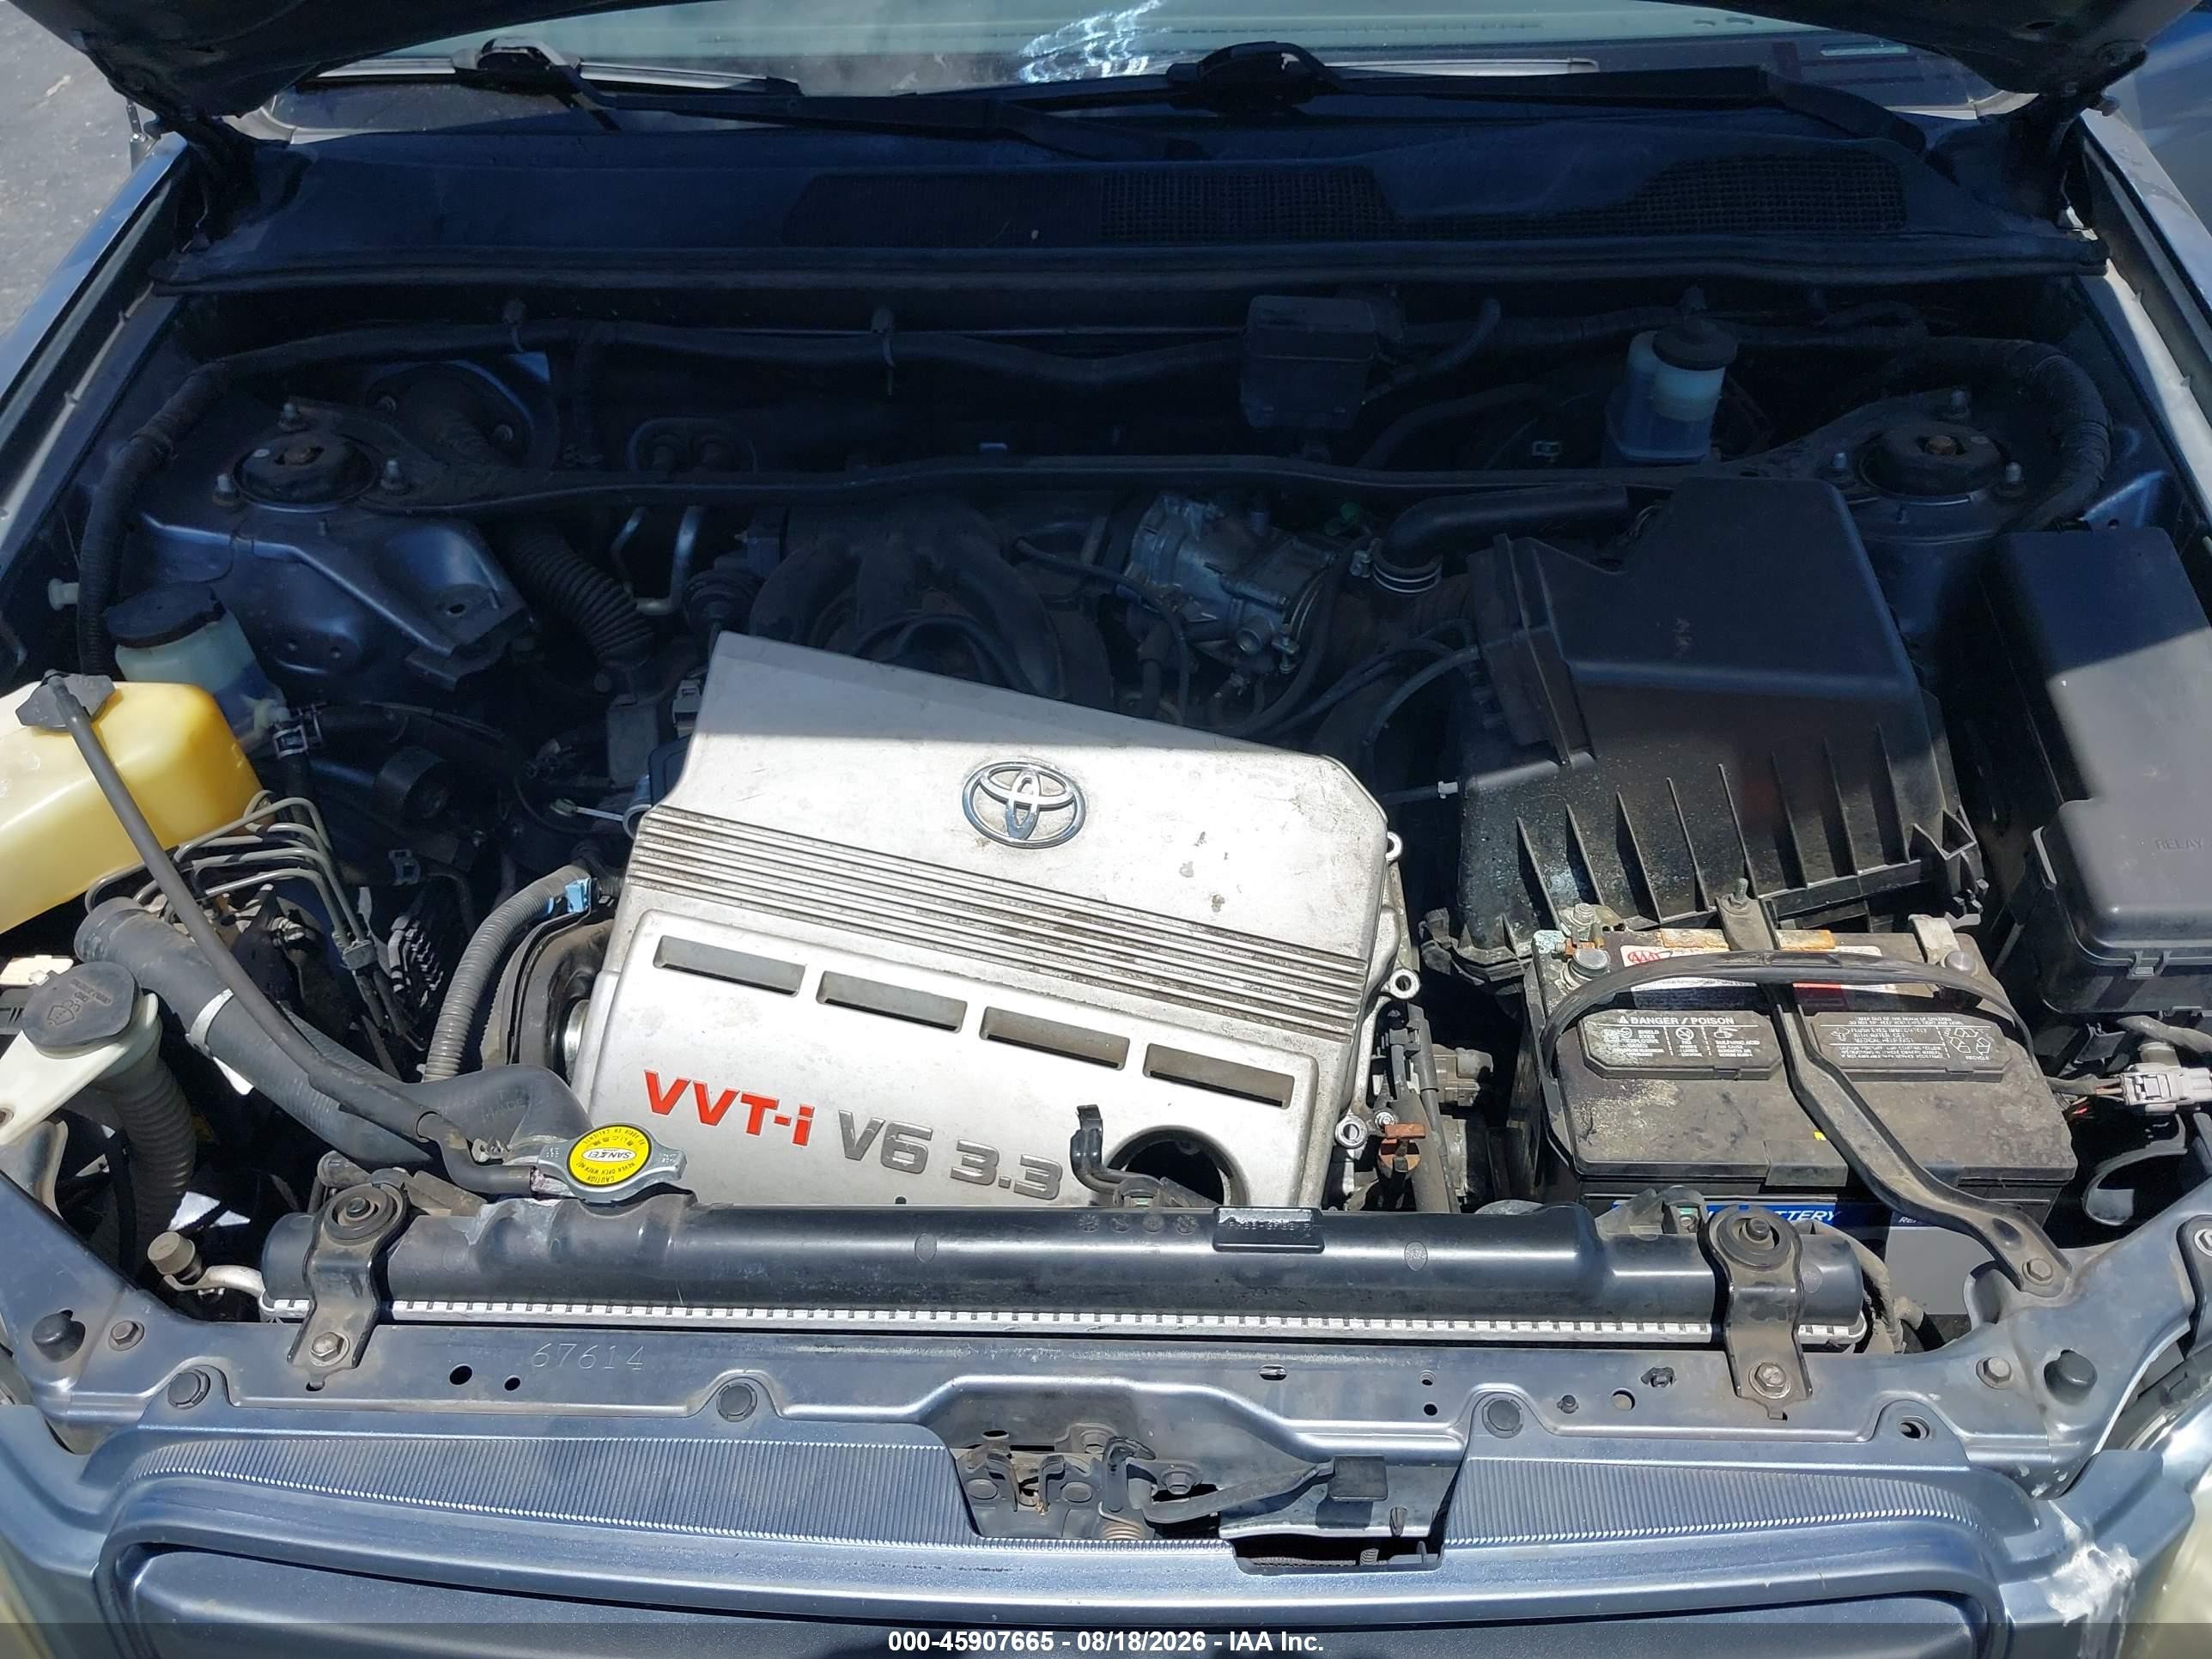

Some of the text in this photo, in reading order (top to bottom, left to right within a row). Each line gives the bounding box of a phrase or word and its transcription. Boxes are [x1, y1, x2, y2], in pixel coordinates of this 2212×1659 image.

[2154, 837, 2203, 850] RELAY
[1628, 951, 1661, 963] AAA
[1632, 1017, 1679, 1025] DANGER
[1691, 1017, 1735, 1025] POISON
[643, 1068, 1064, 1200] VVT-i V6 3.3
[617, 1162, 635, 1173] NEVER
[586, 1175, 615, 1183] CAUTION
[531, 1340, 647, 1371] 67614
